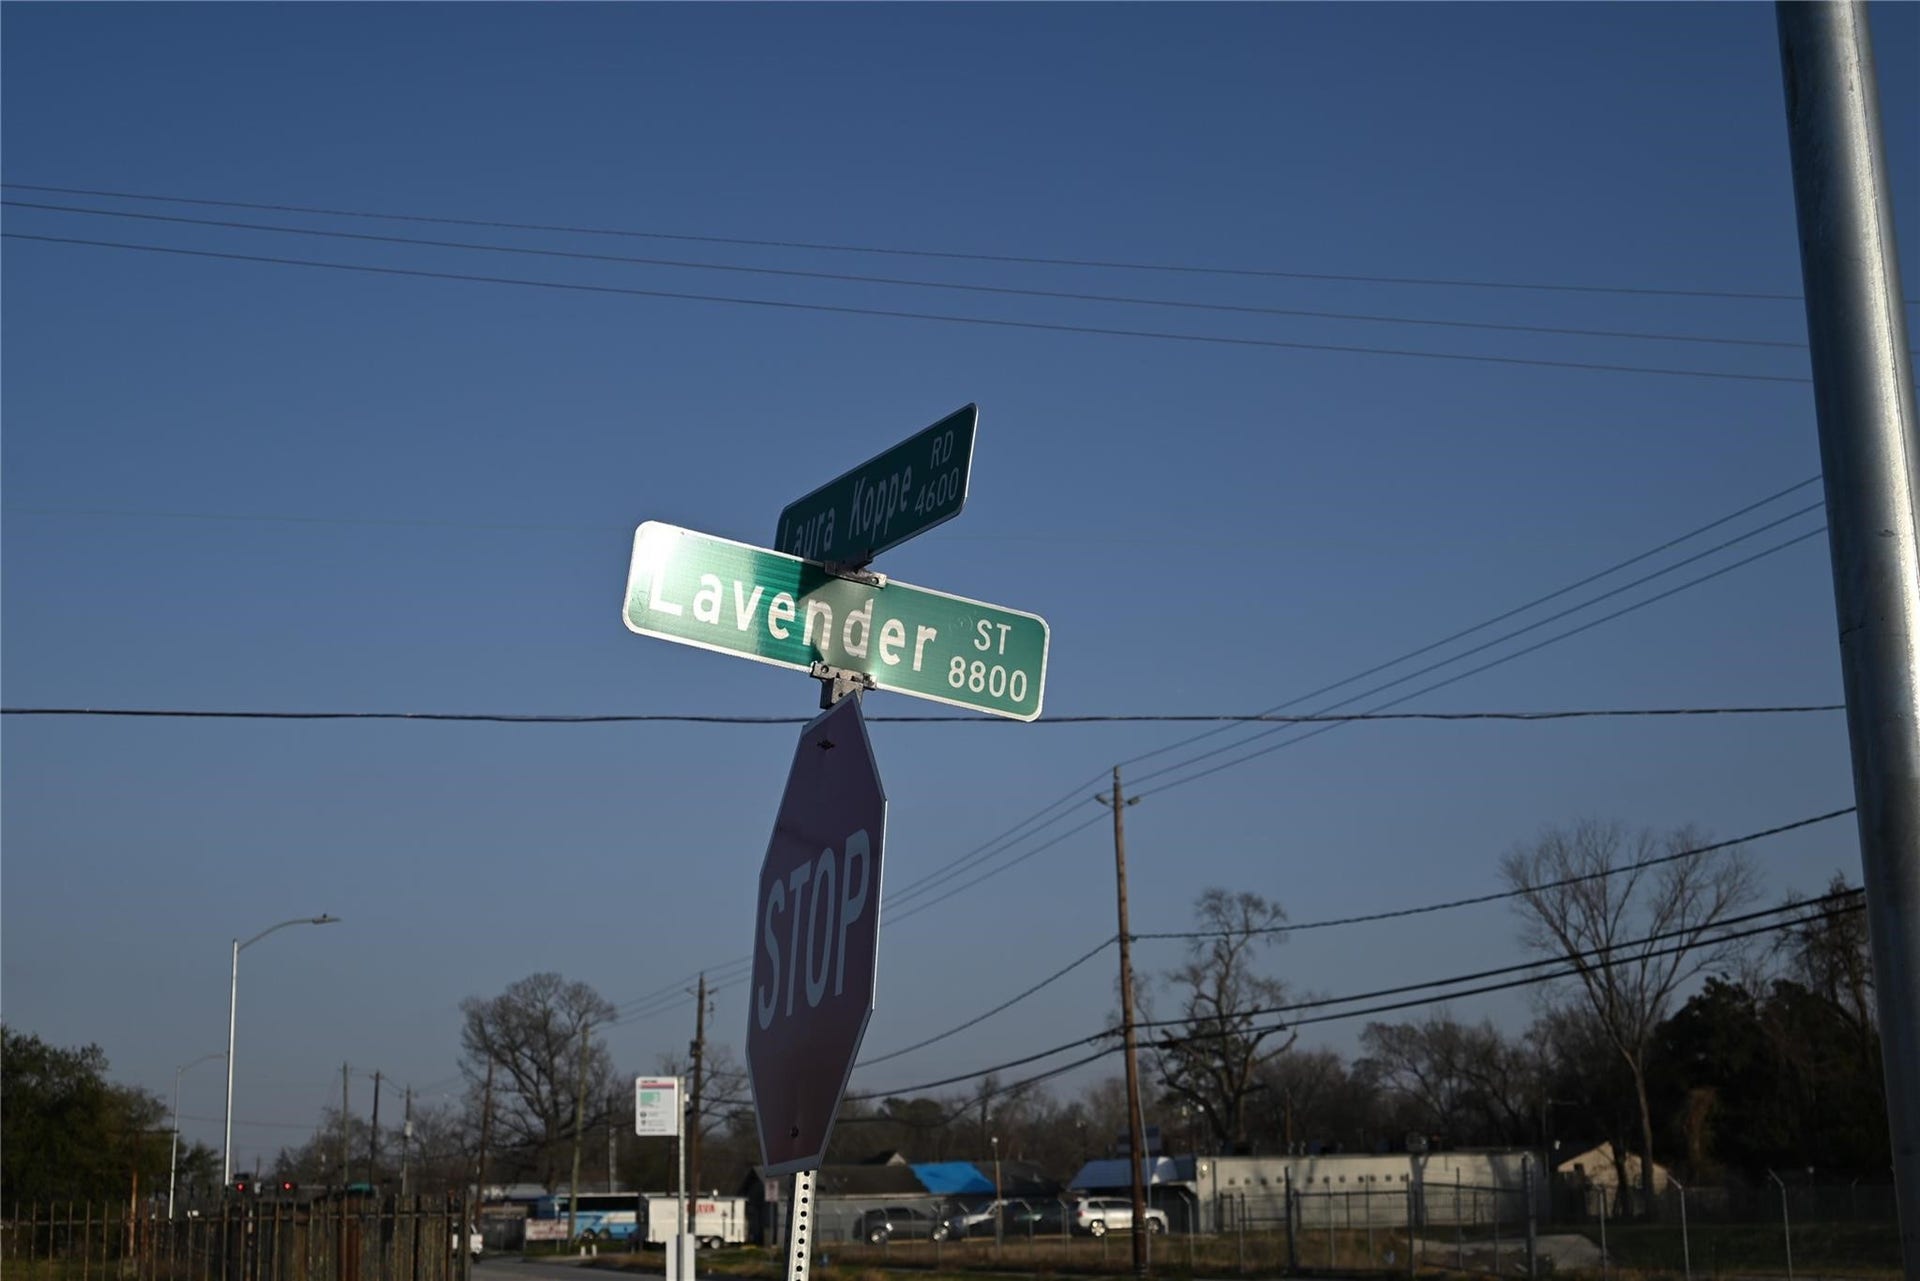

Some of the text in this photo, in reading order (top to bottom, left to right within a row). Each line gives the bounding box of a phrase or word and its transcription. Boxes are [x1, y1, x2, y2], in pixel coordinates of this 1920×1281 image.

[930, 430, 954, 469] RD
[848, 464, 912, 544] Koppe
[915, 467, 959, 516] 4600
[648, 557, 937, 672] Lavender
[974, 619, 1012, 656] ST
[948, 656, 1028, 703] 8800
[757, 829, 871, 1031] STOP
